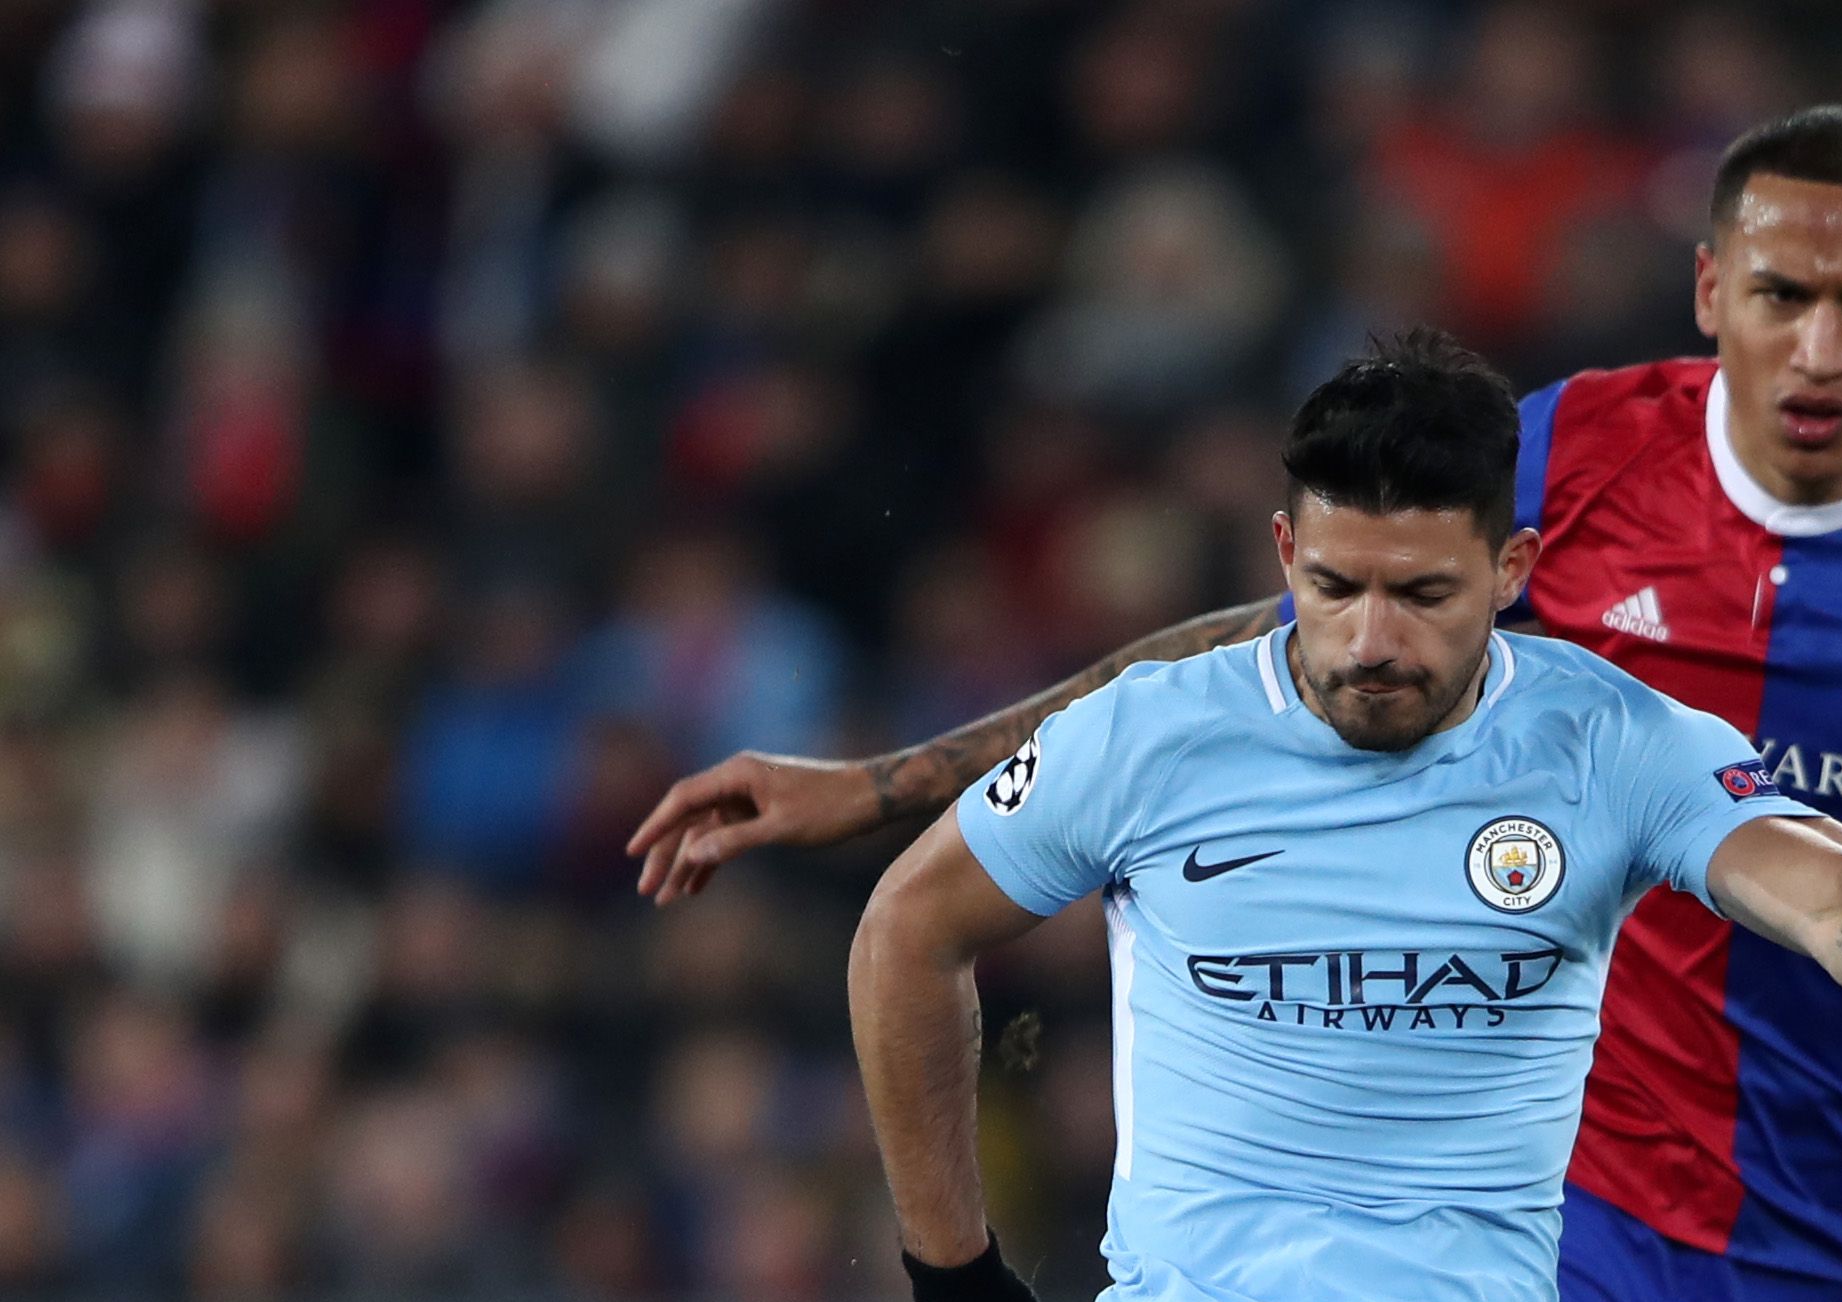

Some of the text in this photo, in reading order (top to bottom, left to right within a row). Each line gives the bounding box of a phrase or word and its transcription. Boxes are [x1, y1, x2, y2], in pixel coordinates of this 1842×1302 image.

[1602, 610, 1669, 642] adidas
[1476, 823, 1553, 853] MANCHESTER
[1503, 896, 1531, 906] CITY
[1187, 948, 1564, 1006] ETIHAD
[1257, 1001, 1506, 1031] AIRWAYS
